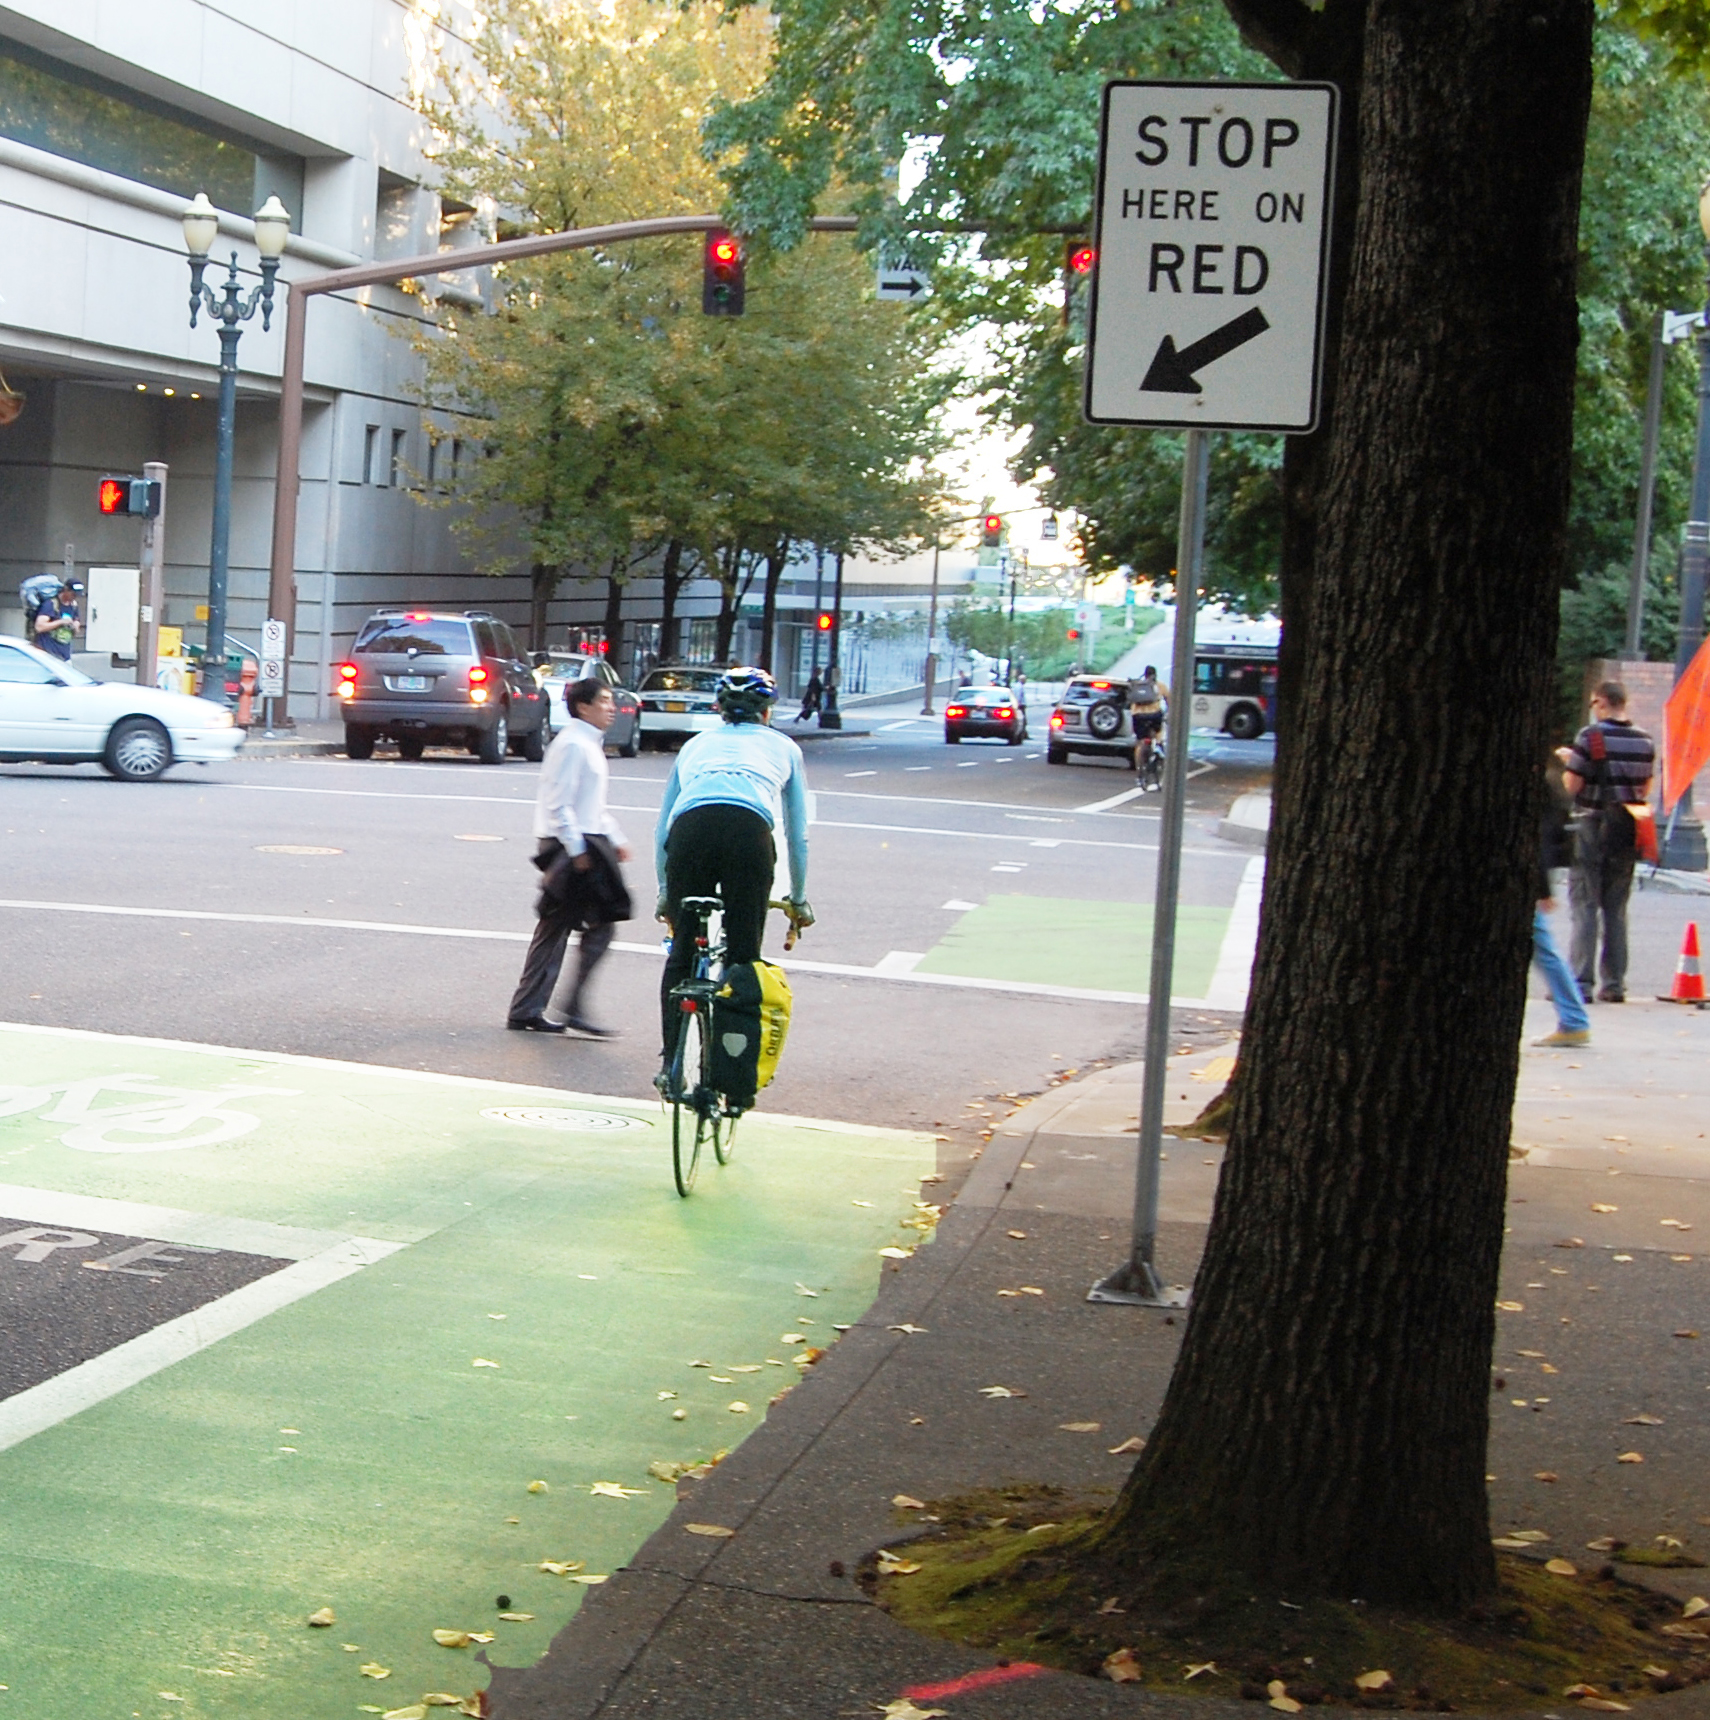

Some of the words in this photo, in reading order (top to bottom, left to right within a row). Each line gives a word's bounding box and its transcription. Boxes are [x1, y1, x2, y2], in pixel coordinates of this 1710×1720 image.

[1135, 115, 1299, 168] STOP
[1122, 188, 1219, 220] HERE
[1256, 191, 1304, 223] ON
[1149, 243, 1269, 295] RED
